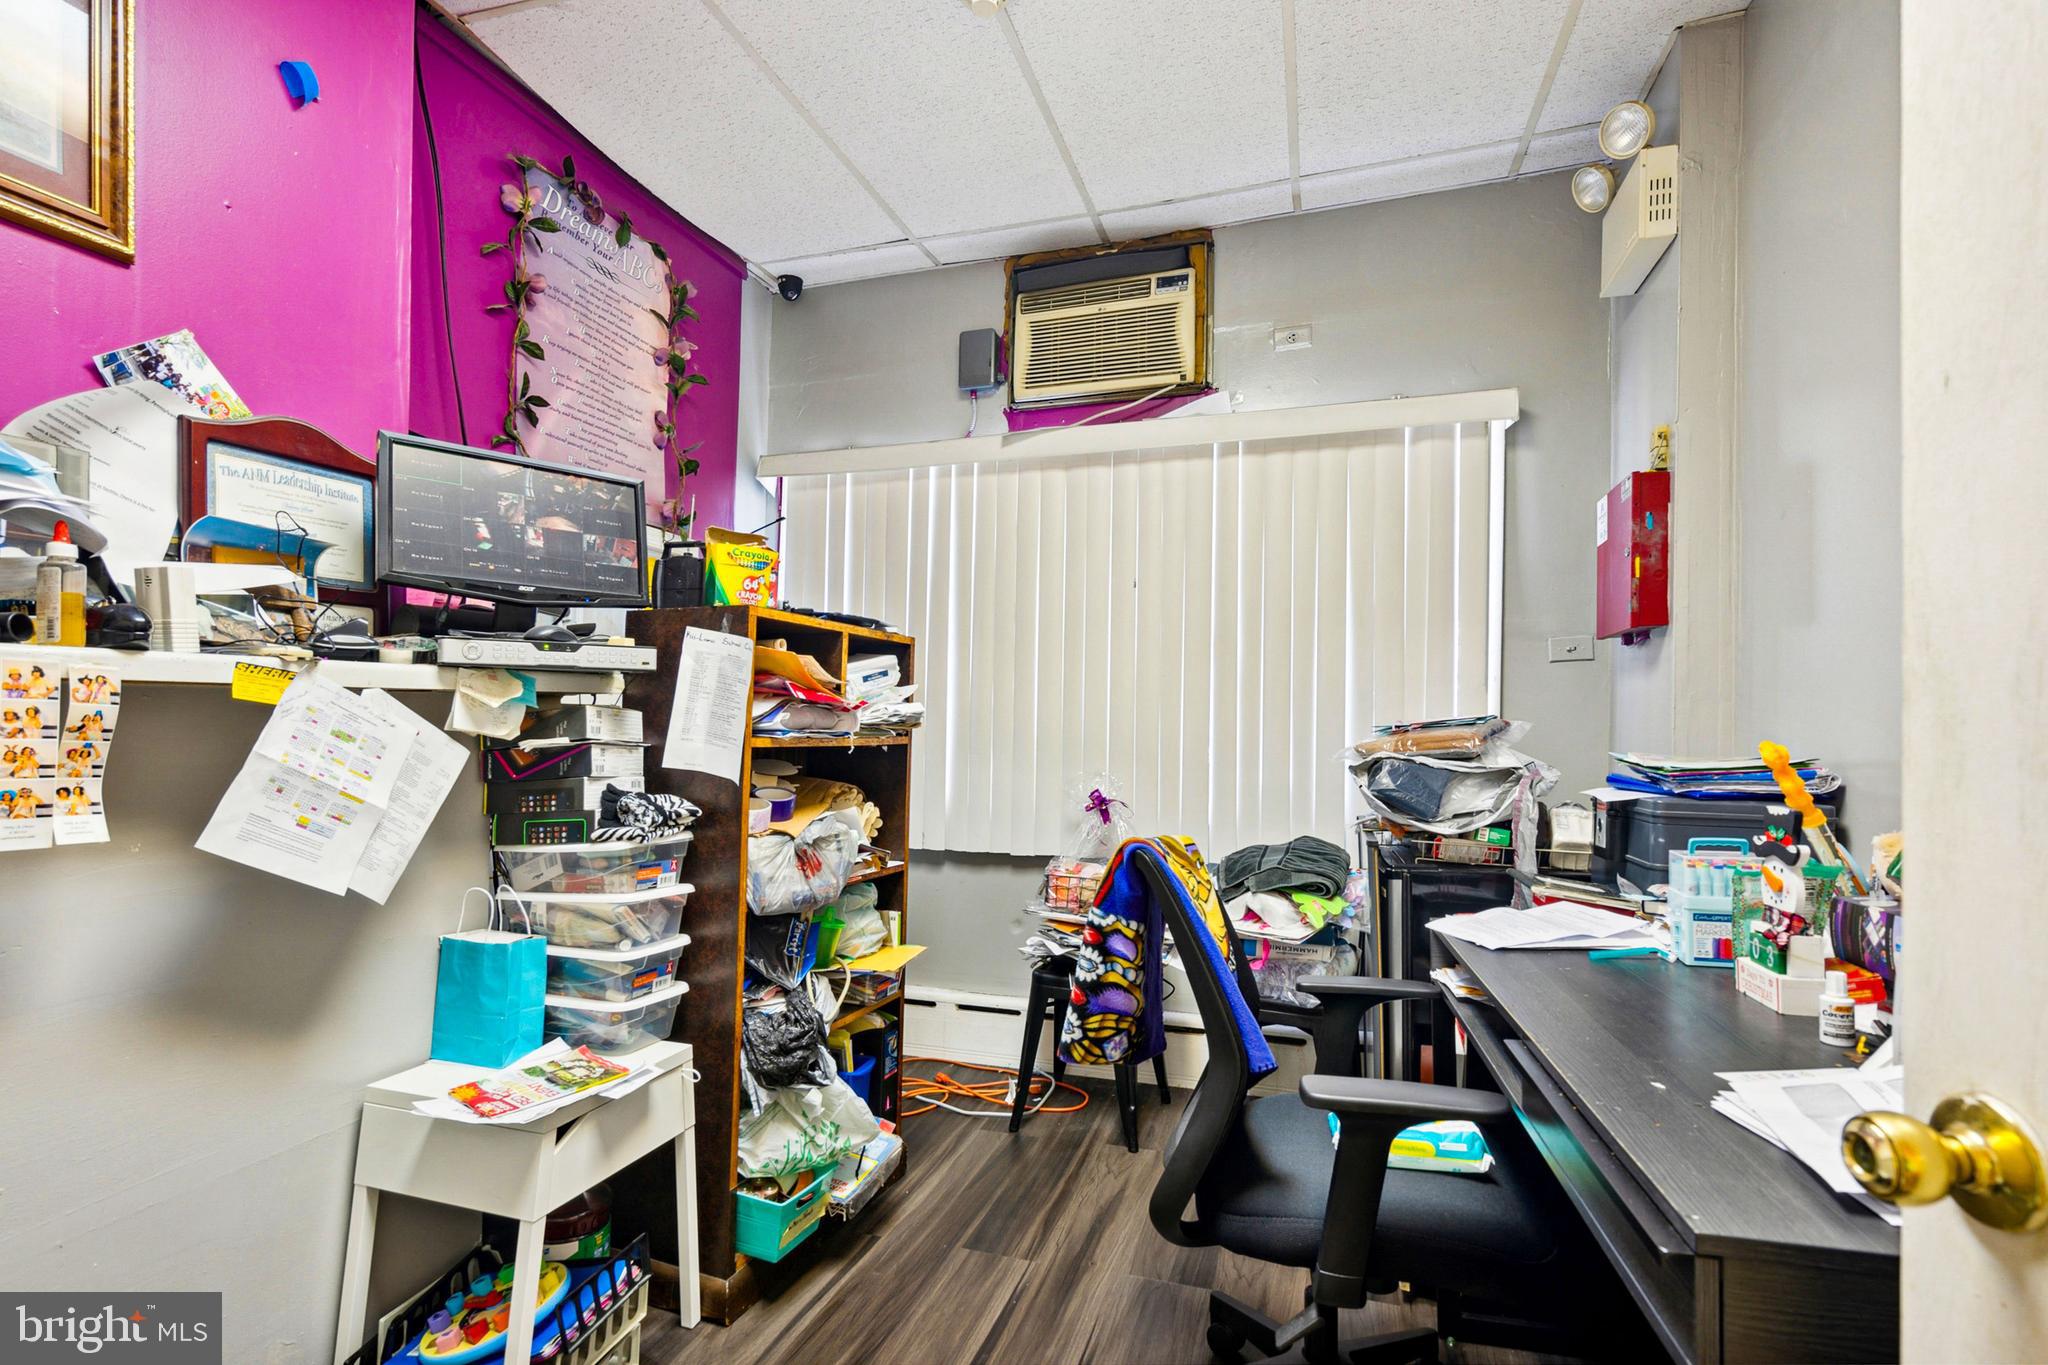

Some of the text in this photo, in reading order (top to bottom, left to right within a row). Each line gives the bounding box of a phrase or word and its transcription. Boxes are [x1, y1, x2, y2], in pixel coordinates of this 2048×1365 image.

[540, 184, 618, 255] Dreams
[592, 242, 613, 261] Your
[614, 249, 663, 294] ABCs
[219, 465, 240, 478] The
[273, 470, 323, 497] Leadership
[732, 547, 770, 561] Crayola
[743, 578, 760, 591] 64
[236, 661, 297, 681] SHERIF
[1696, 928, 1732, 937] MARKER
[1269, 943, 1318, 954] HAMMERMI
